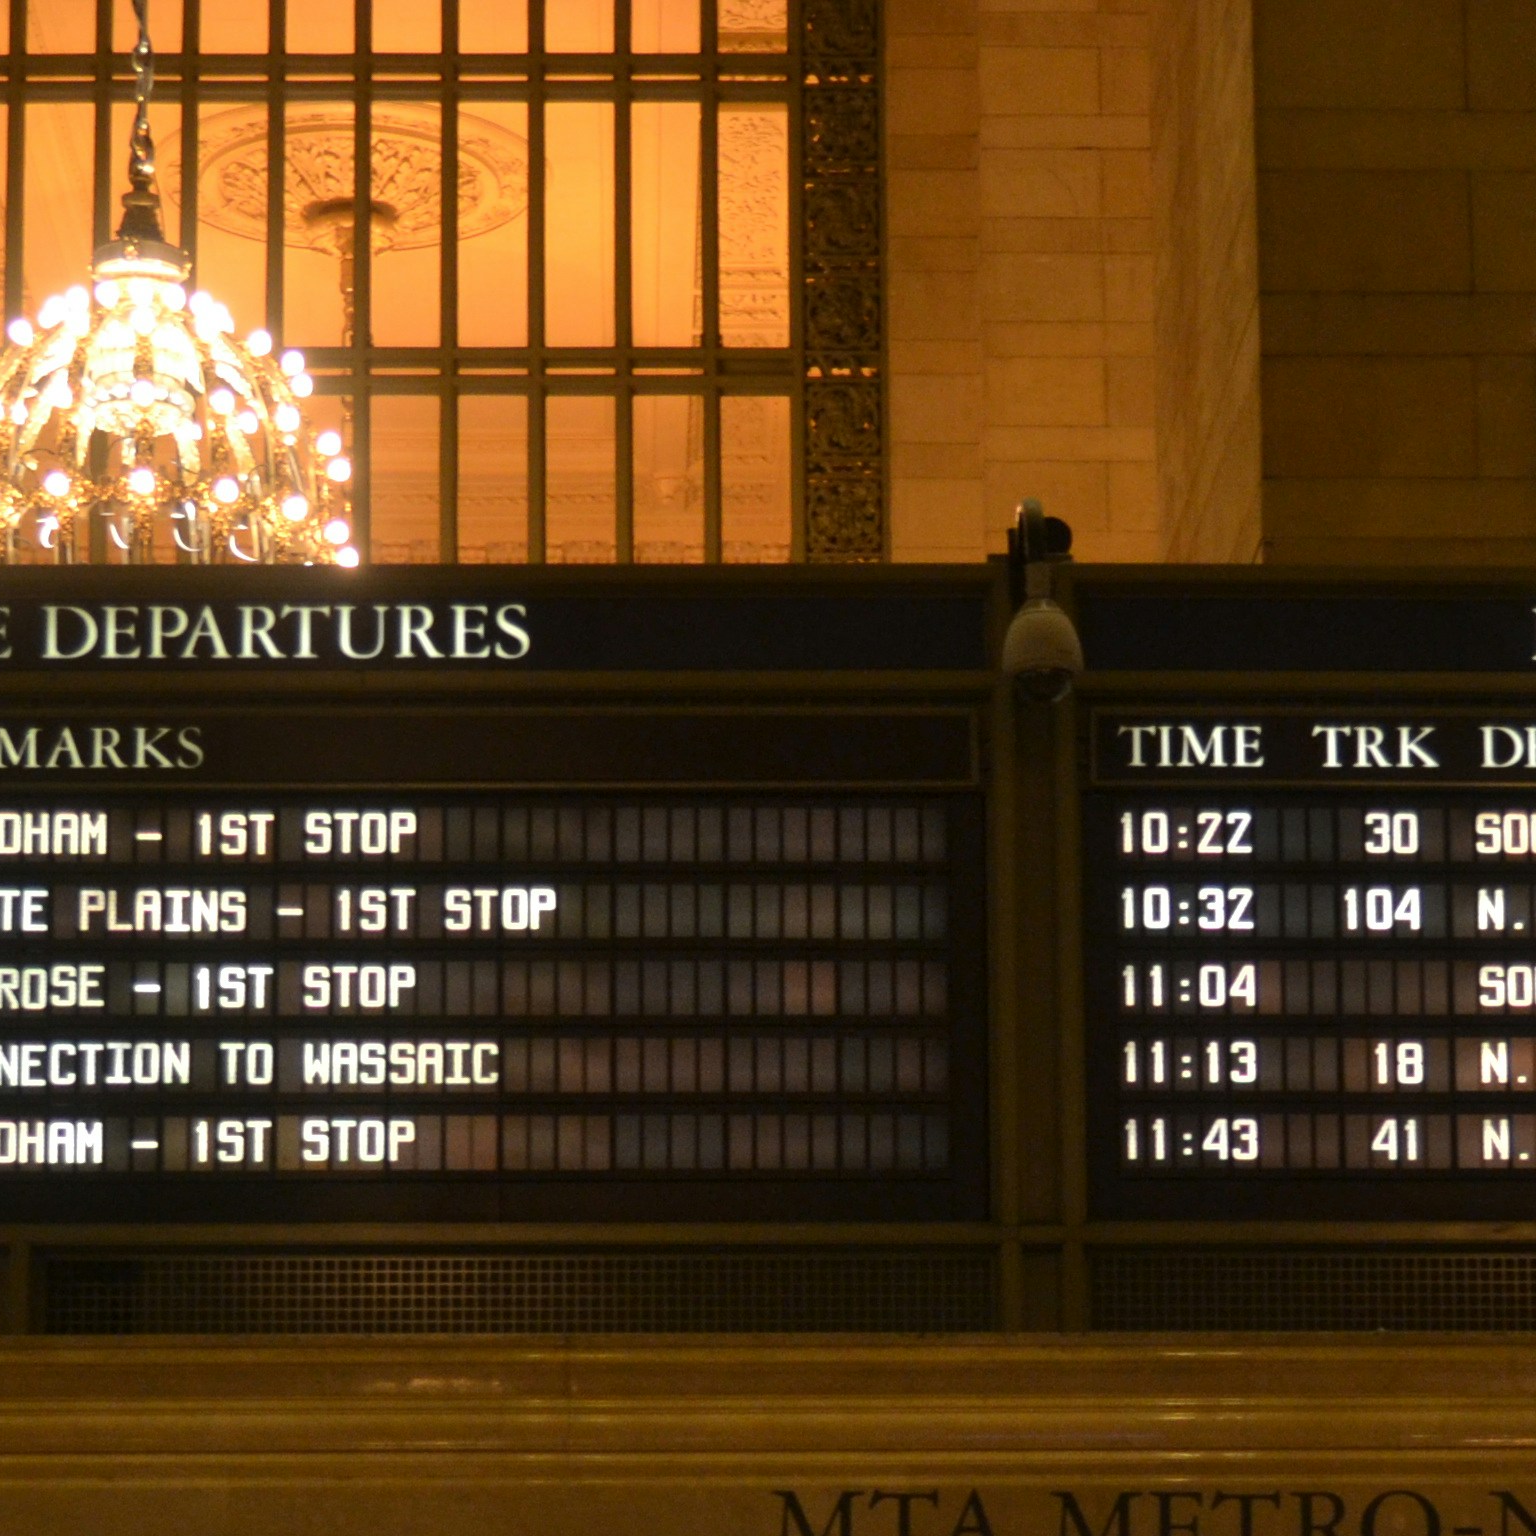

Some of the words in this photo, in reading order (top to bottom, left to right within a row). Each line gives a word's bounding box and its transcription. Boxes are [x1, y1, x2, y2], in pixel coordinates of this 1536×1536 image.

[41, 604, 531, 660] DEPARTURES
[1119, 725, 1264, 768] TIME
[1311, 725, 1439, 768] TRK
[136, 831, 162, 841] -
[198, 812, 275, 855] 1ST
[305, 811, 417, 855] STOP
[1121, 811, 1252, 854] 10:22
[1365, 812, 1418, 854] 30
[79, 889, 246, 933] PLAINS
[277, 906, 303, 916] -
[337, 888, 416, 932] 1ST
[444, 887, 556, 931] STOP
[1122, 886, 1254, 930] 10:32
[1344, 887, 1421, 931] 104
[1478, 889, 1524, 931] N.
[133, 982, 161, 992] -
[195, 965, 274, 1010] 1ST
[303, 964, 416, 1009] STOP
[1123, 964, 1256, 1007] 11:04
[219, 1042, 273, 1085] TO
[303, 1041, 499, 1085] WASSAIC
[1124, 1041, 1257, 1084] 11:13
[1374, 1042, 1424, 1085] 18
[1481, 1043, 1528, 1084] N.
[131, 1140, 158, 1149] -
[194, 1120, 272, 1163] 1ST
[302, 1119, 415, 1163] STOP
[1125, 1118, 1258, 1161] 11:43
[1371, 1118, 1418, 1161] 41
[1482, 1119, 1530, 1161] N.
